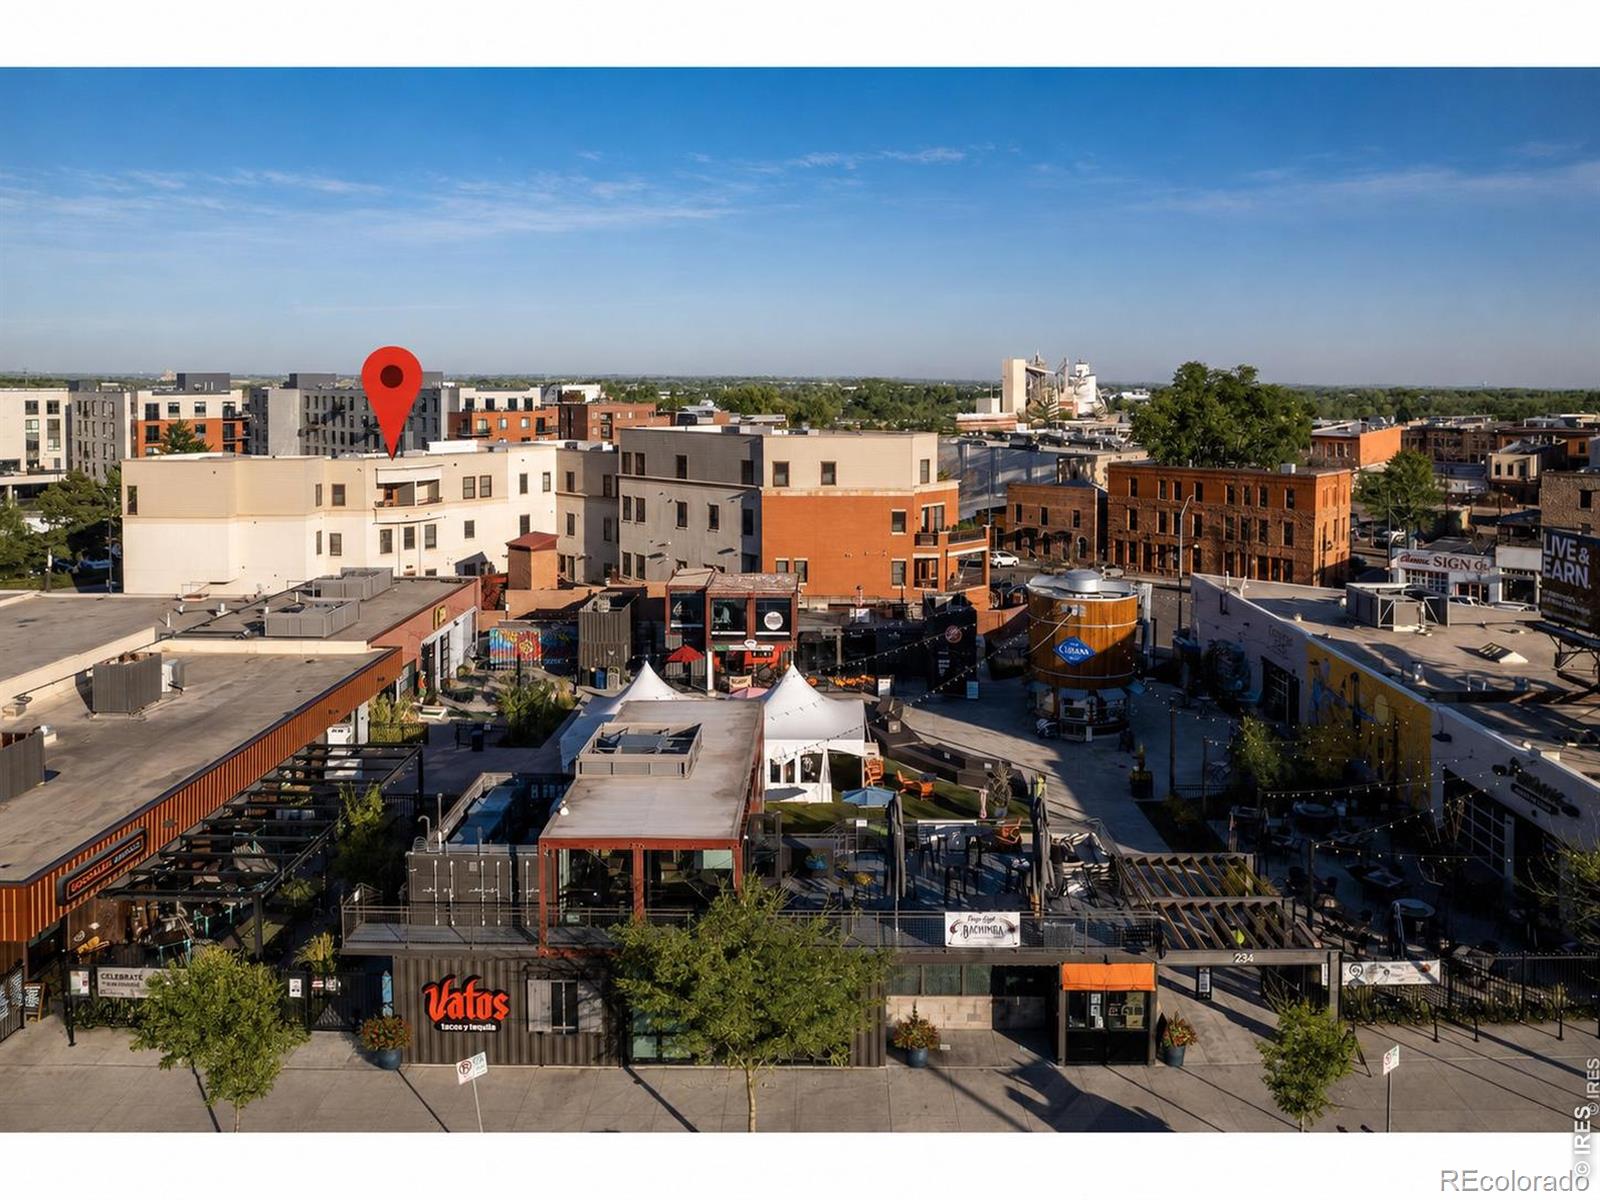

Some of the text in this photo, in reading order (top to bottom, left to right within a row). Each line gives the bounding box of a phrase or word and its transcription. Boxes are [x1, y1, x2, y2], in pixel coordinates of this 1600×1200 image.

[1543, 533, 1590, 566] LIVE &
[1433, 555, 1471, 571] SIGN
[1542, 556, 1592, 590] EARN.
[100, 973, 143, 981] CELEBRATE
[423, 977, 510, 1021] Vatos
[441, 1023, 462, 1031] tacos
[469, 1023, 497, 1032] tequila
